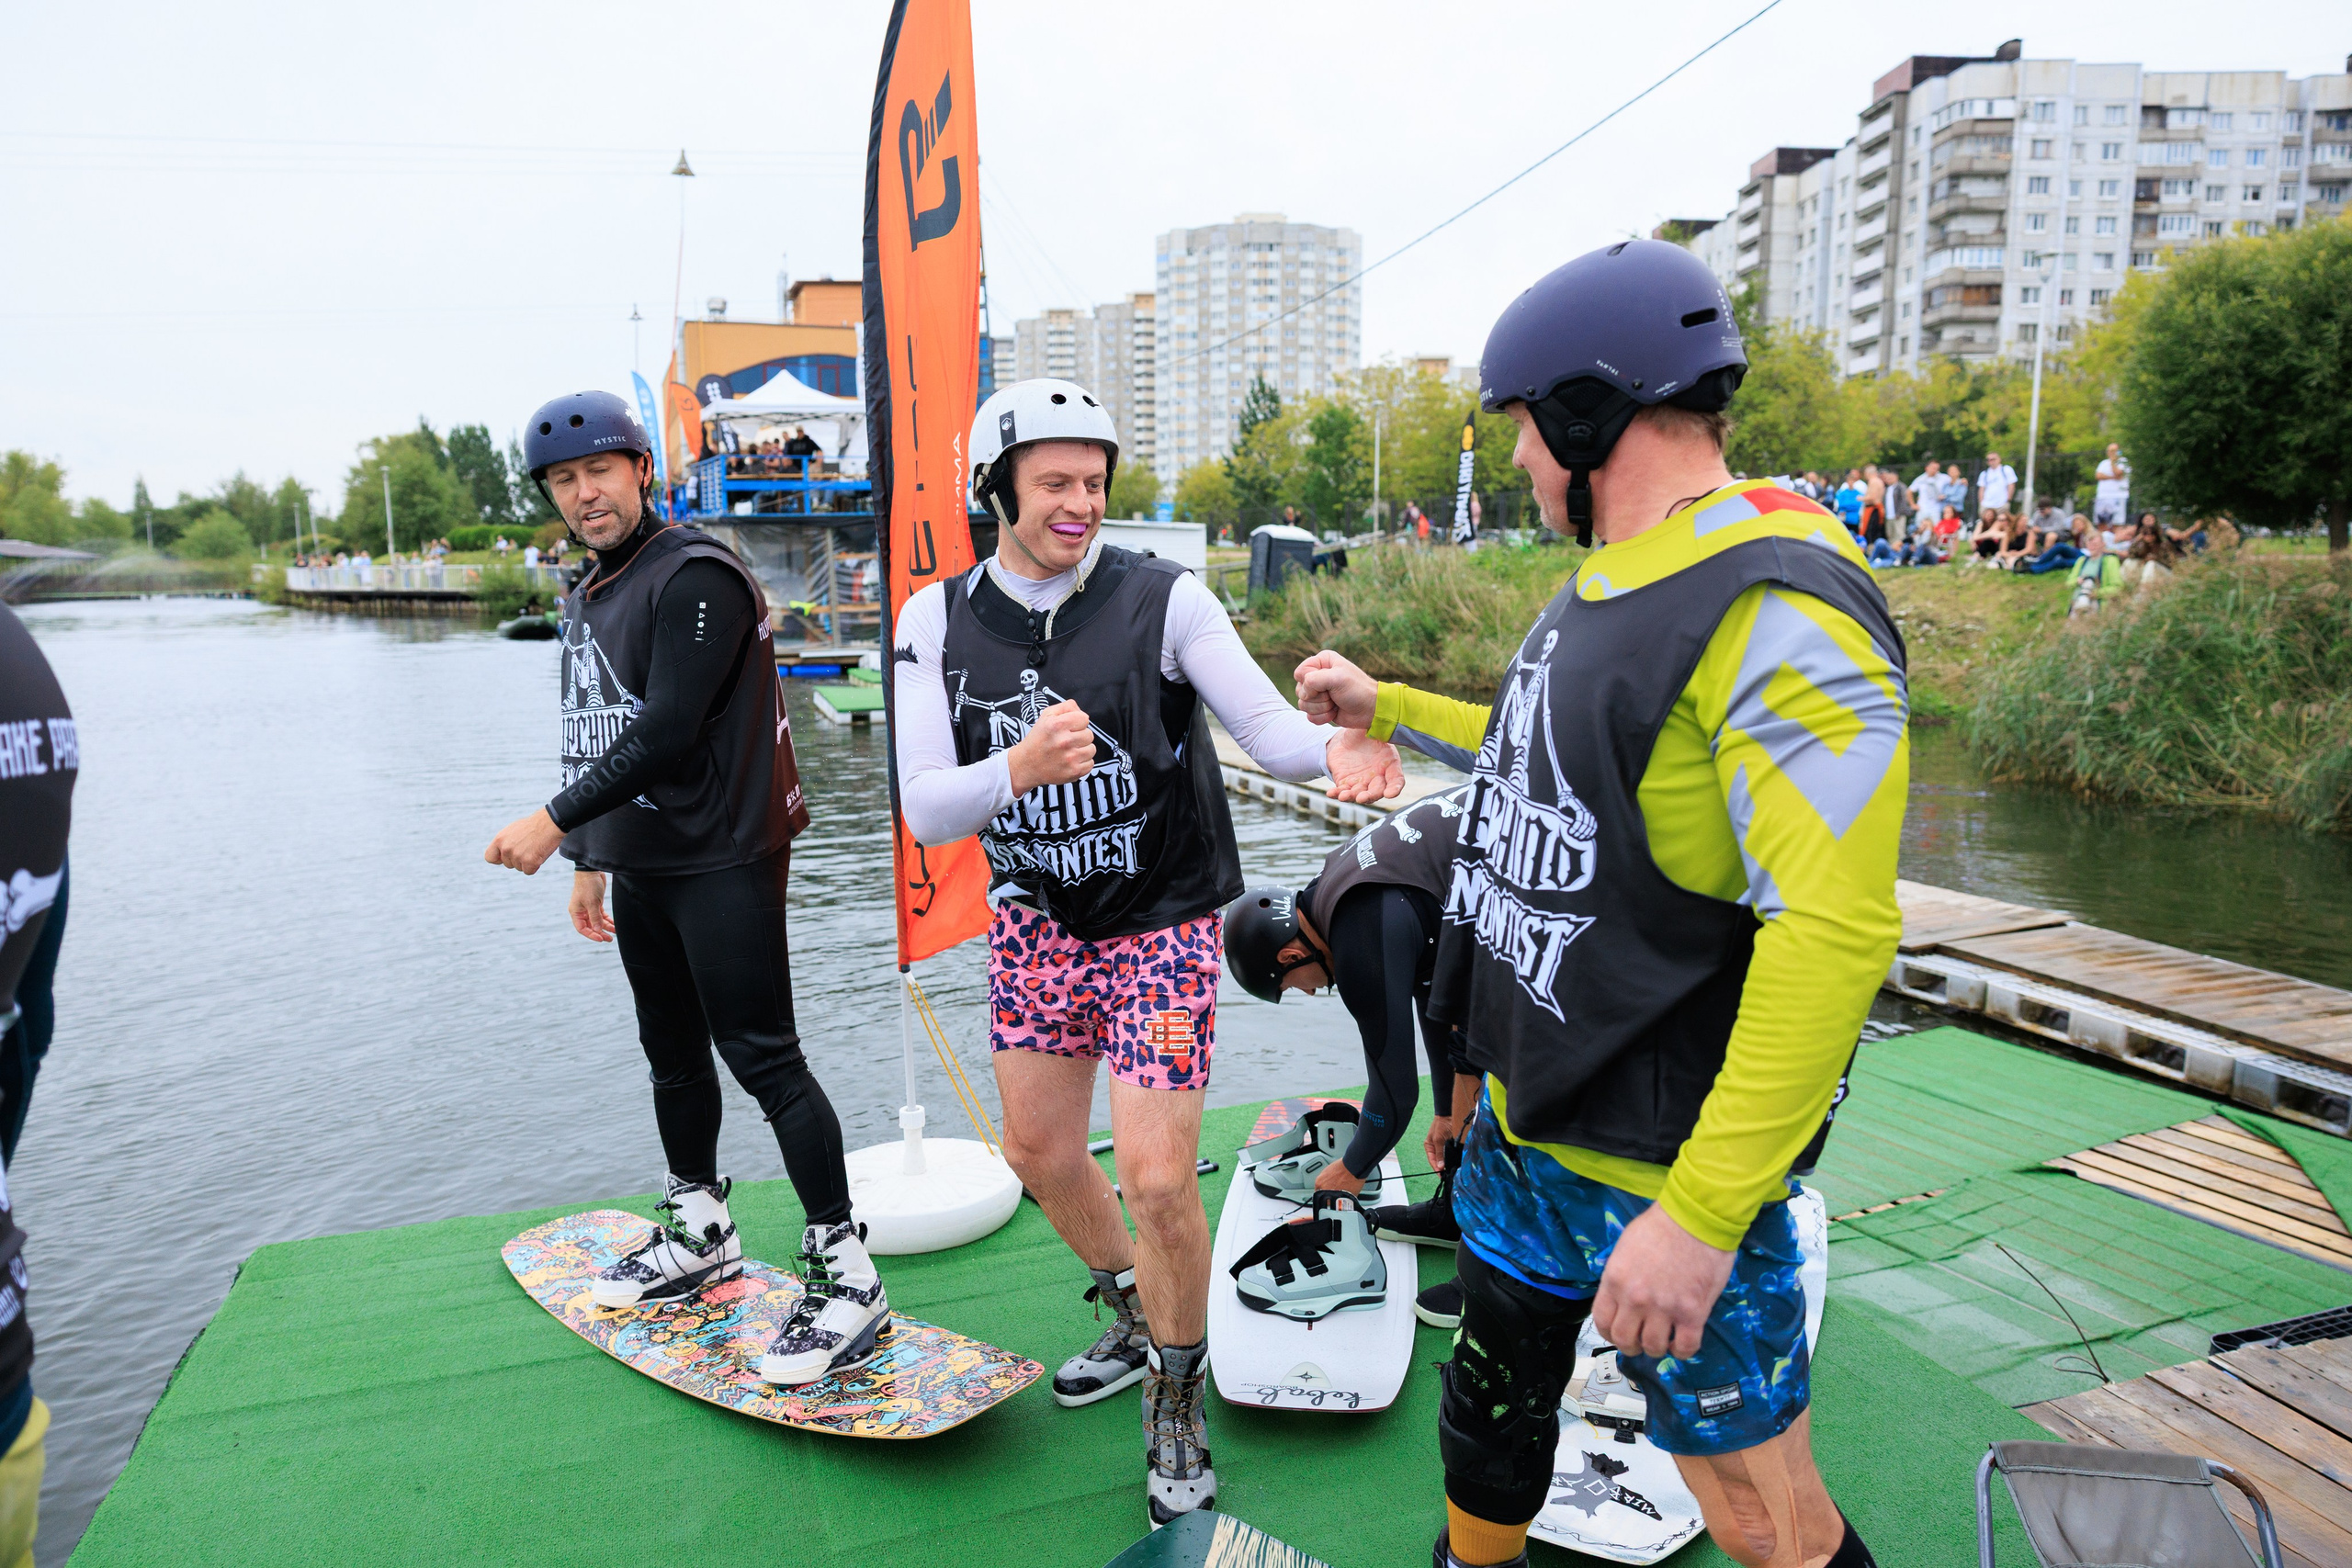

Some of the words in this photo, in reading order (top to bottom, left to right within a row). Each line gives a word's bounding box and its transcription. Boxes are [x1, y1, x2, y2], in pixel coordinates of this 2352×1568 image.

[594, 435, 626, 446] MYSTIC
[0, 718, 48, 780] AKE
[1033, 825, 1141, 882] ONTEST
[1230, 1387, 1376, 1409] kebab
